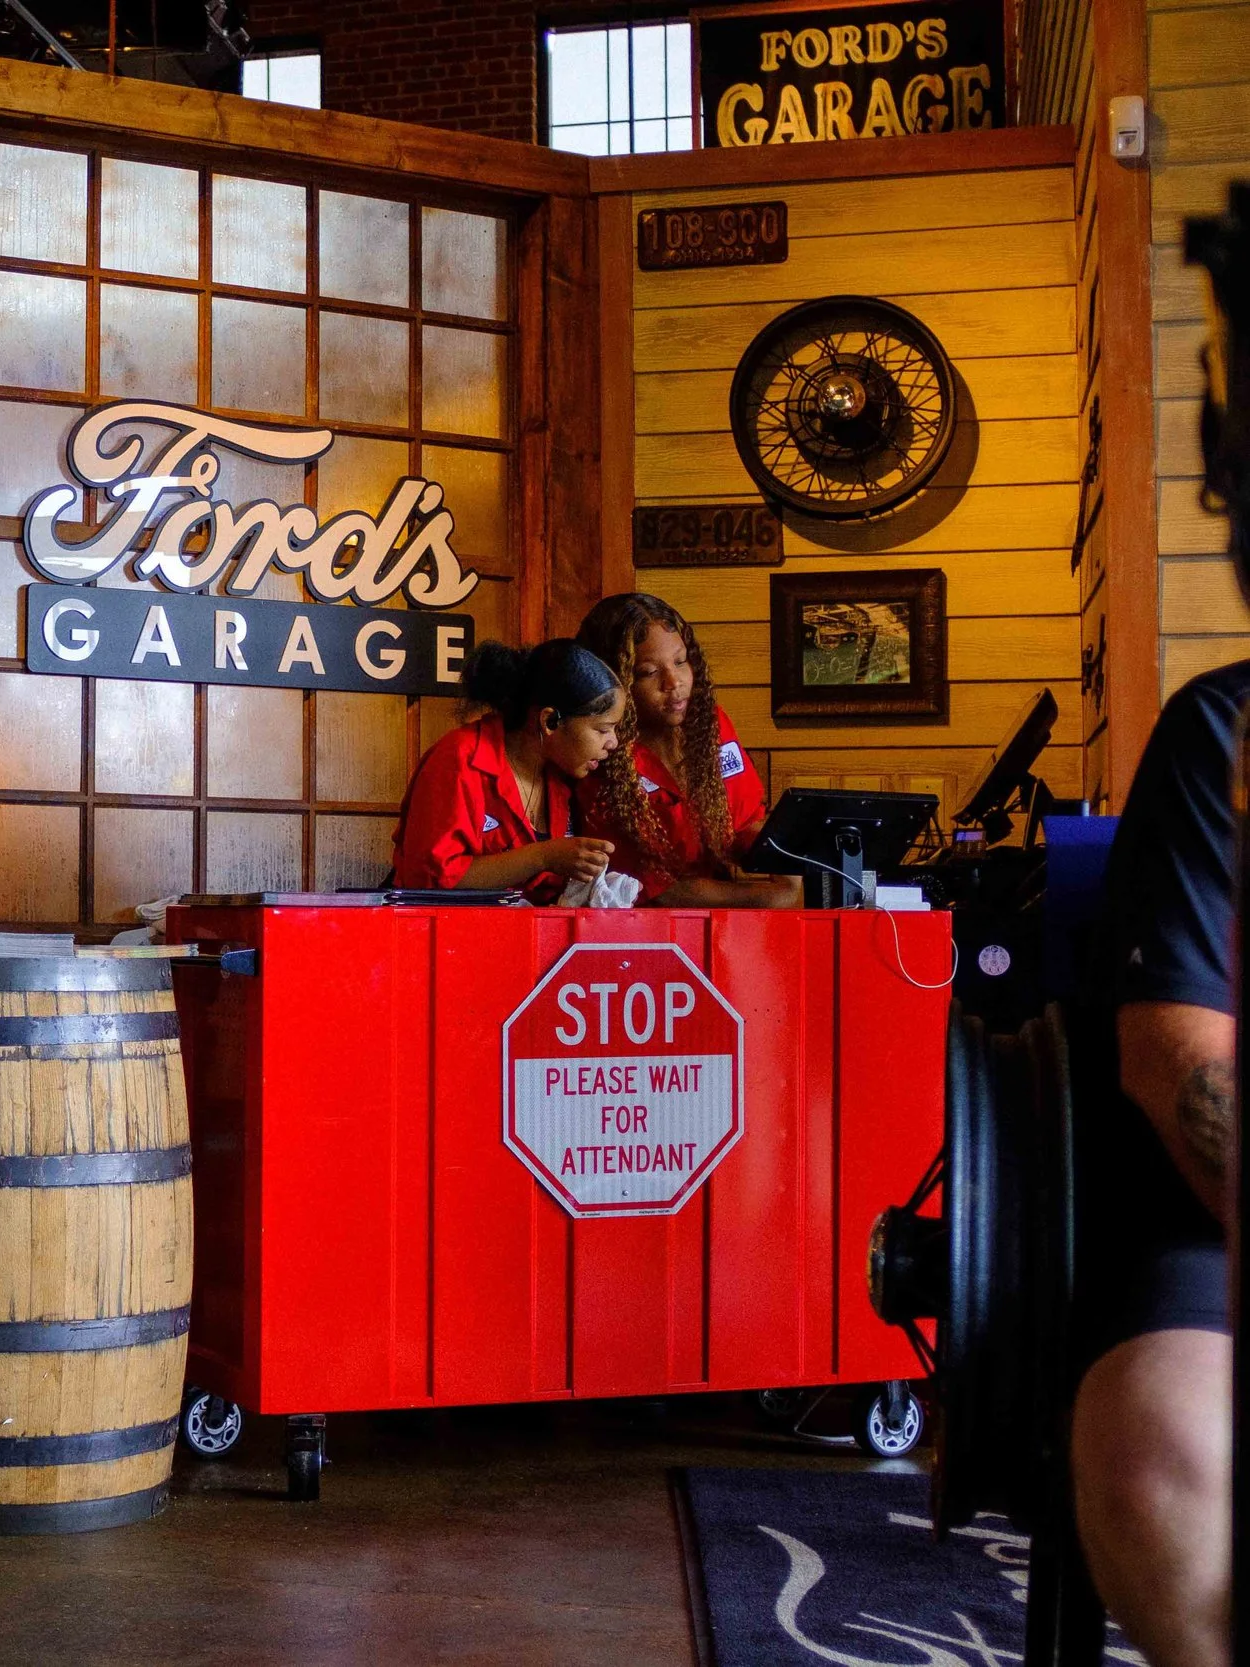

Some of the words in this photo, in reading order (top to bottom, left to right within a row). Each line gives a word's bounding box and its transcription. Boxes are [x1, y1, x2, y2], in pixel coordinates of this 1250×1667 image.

[760, 18, 948, 72] FORD'S
[717, 64, 992, 147] GARAGE
[23, 398, 480, 608] Ford's
[42, 597, 469, 685] GARAGE
[555, 982, 696, 1046] STOP
[546, 1066, 638, 1096] PLEASE
[648, 1064, 703, 1093] WAIT
[601, 1105, 648, 1134] FOR
[560, 1143, 697, 1176] ATTENDANT
